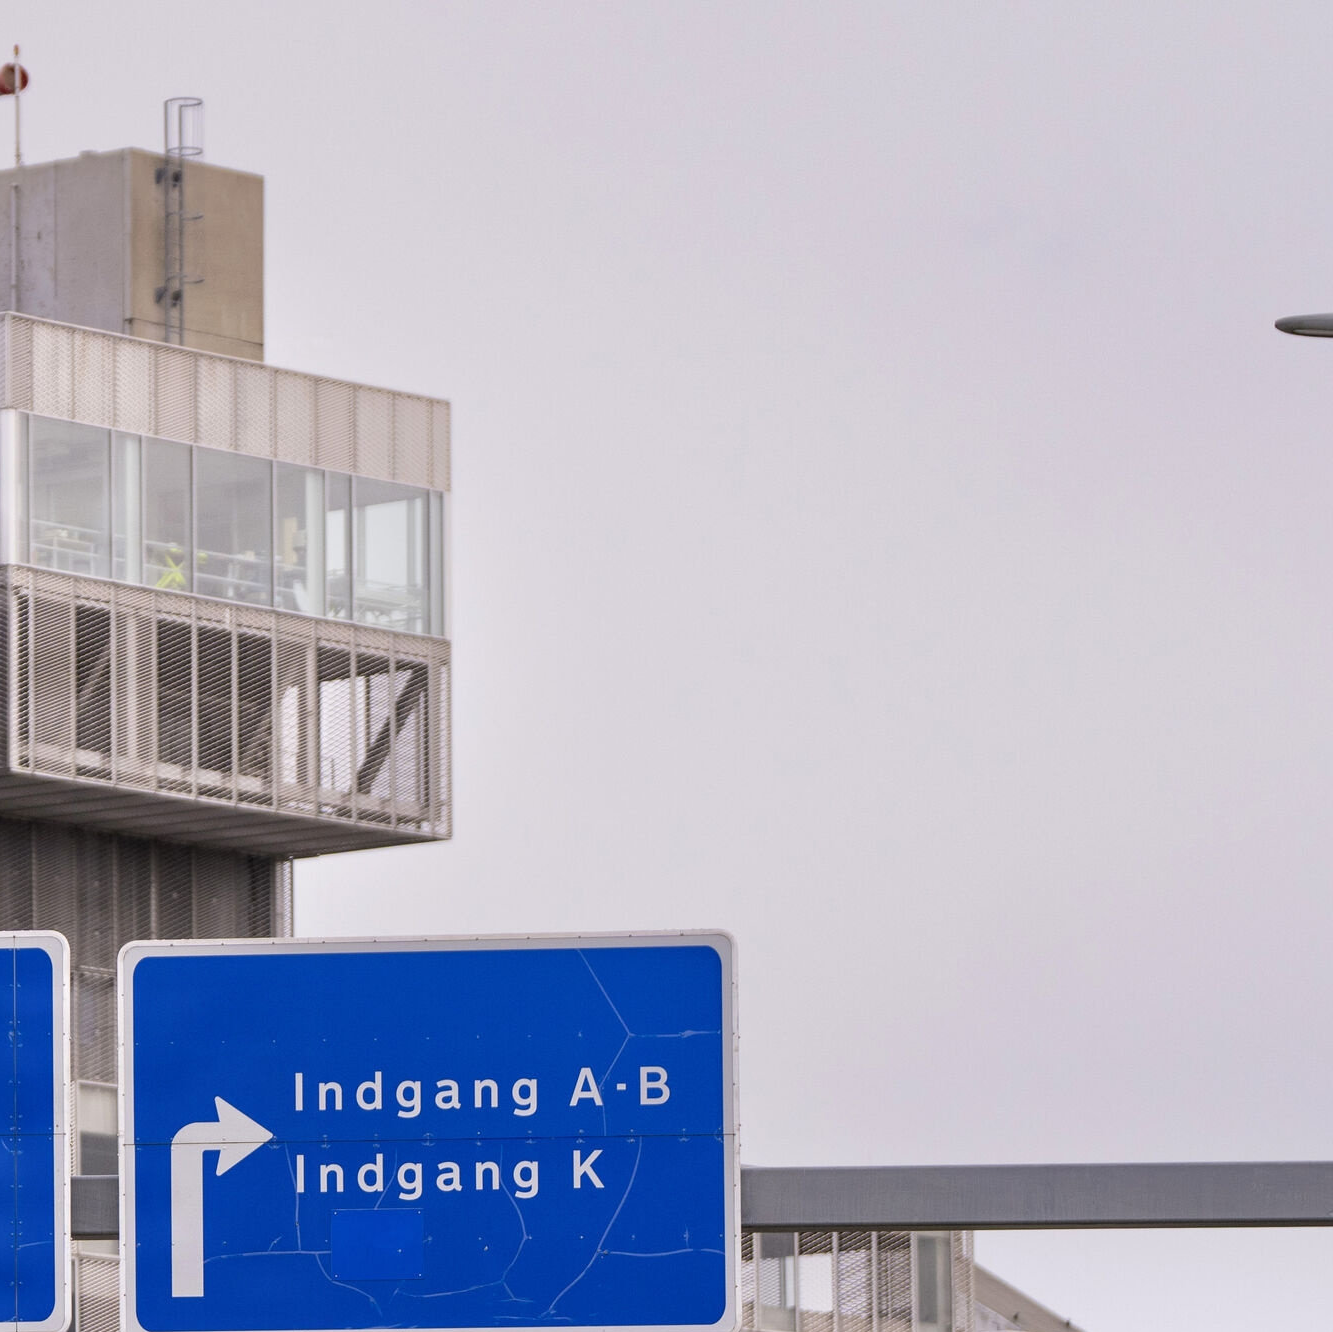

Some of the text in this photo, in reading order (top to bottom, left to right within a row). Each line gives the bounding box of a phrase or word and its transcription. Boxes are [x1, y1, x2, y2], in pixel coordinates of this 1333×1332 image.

[295, 1066, 671, 1118] Indgang A-B
[296, 1149, 606, 1200] Indgang K
